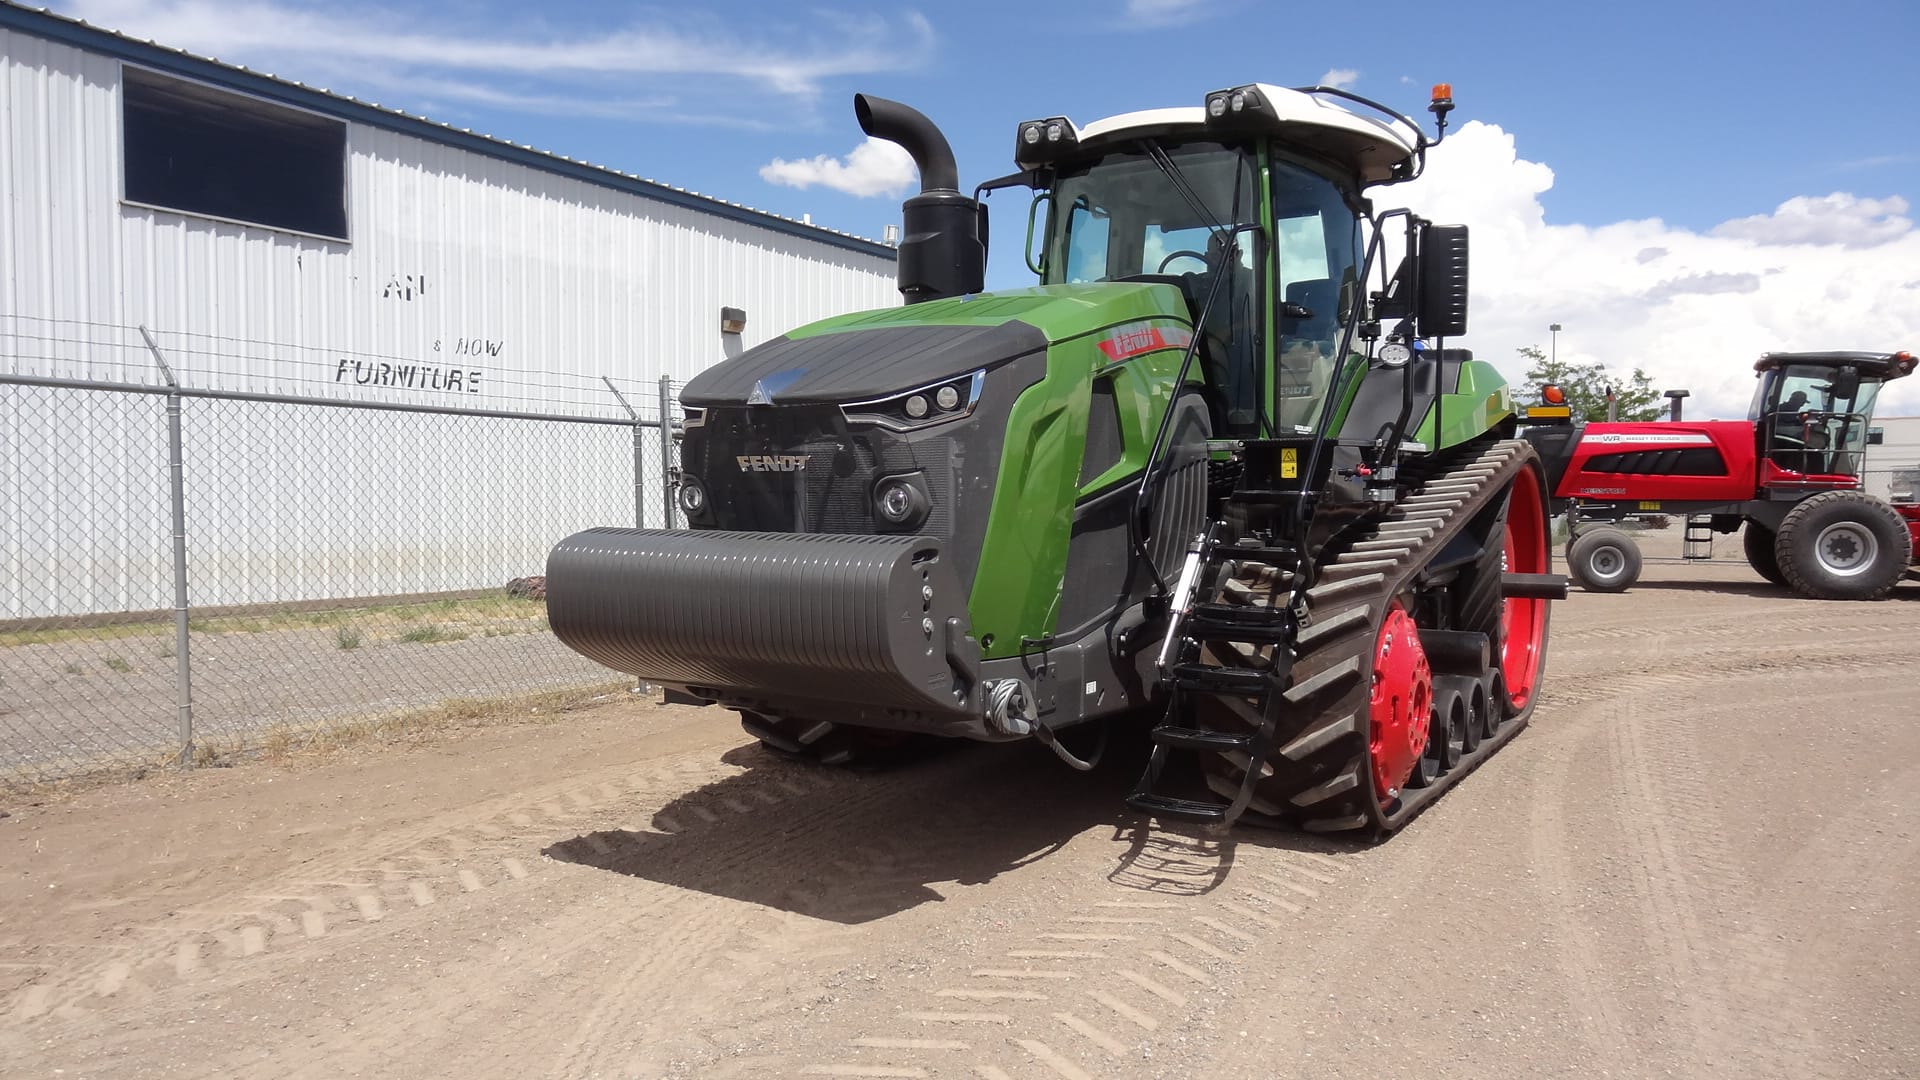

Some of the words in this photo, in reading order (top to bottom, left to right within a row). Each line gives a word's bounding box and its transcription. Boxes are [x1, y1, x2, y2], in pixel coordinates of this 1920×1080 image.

[1111, 322, 1154, 355] FENDT
[336, 359, 481, 393] FURNITURE
[736, 455, 811, 472] FENDT
